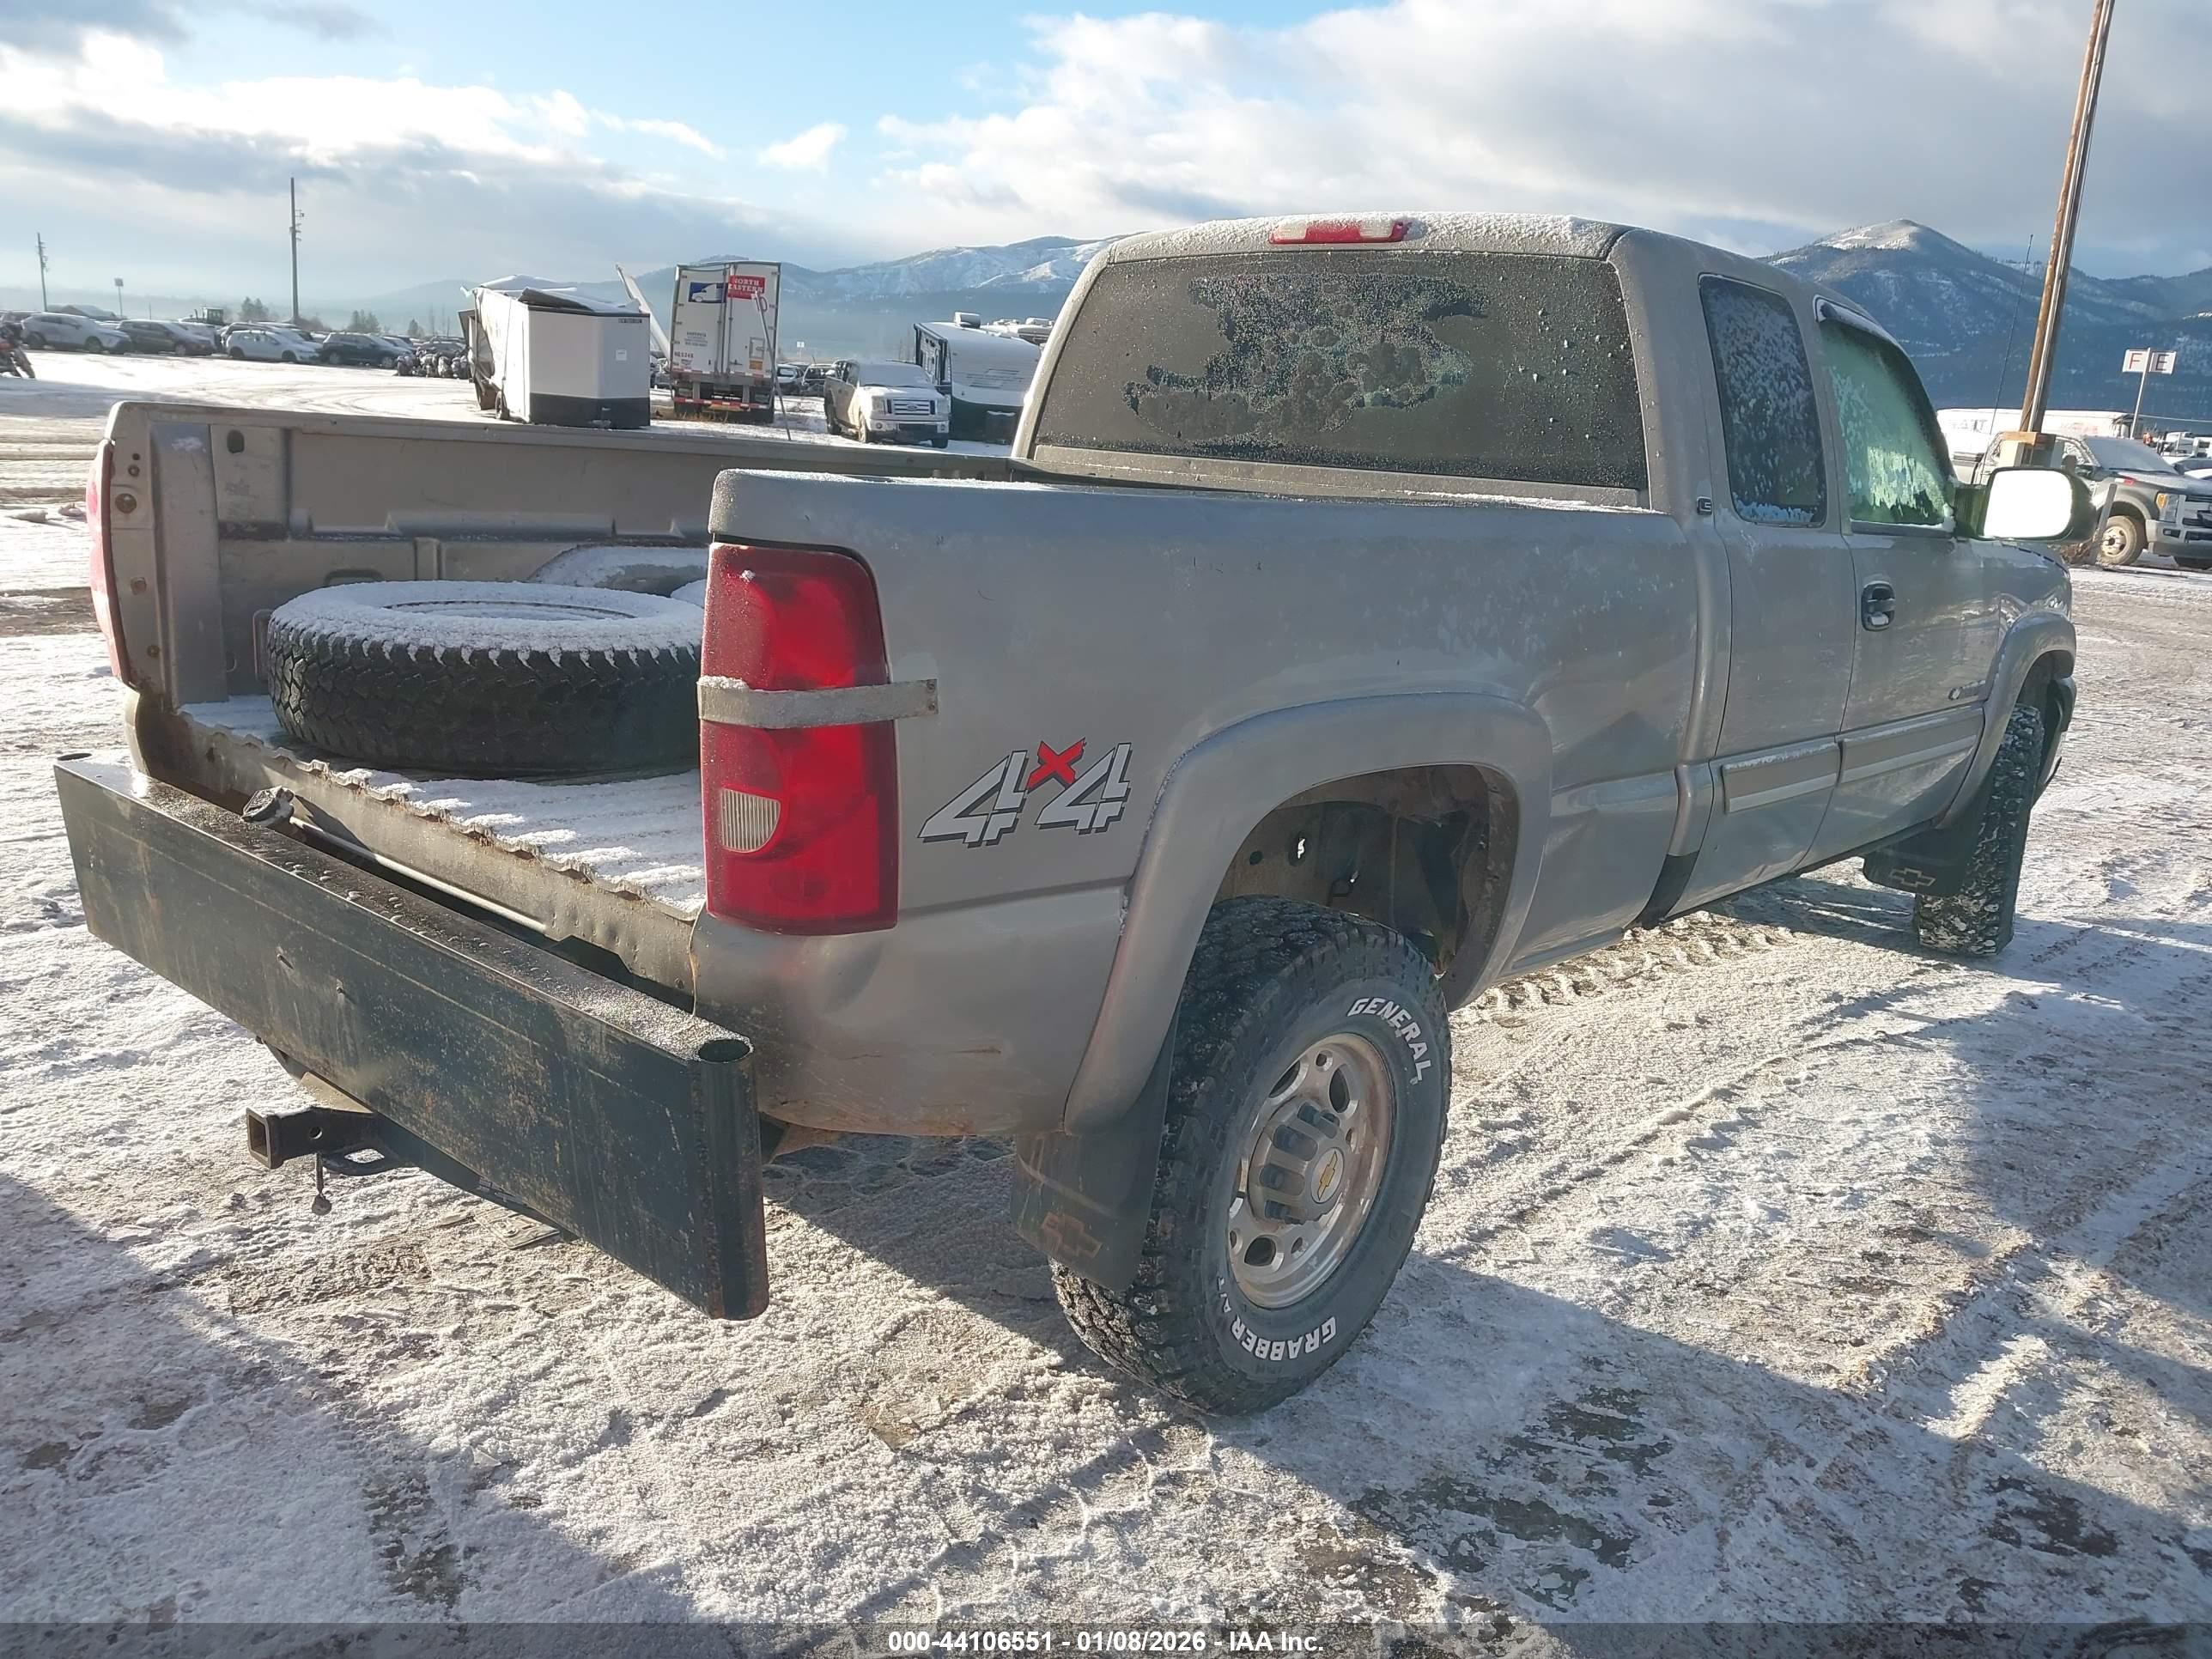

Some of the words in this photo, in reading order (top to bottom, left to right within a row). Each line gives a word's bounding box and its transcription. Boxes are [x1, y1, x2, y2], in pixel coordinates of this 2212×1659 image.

[2129, 352, 2143, 370] F
[2154, 354, 2170, 371] E
[1346, 997, 1431, 1081] GENERAL
[1231, 1315, 1337, 1361] GRABBER
